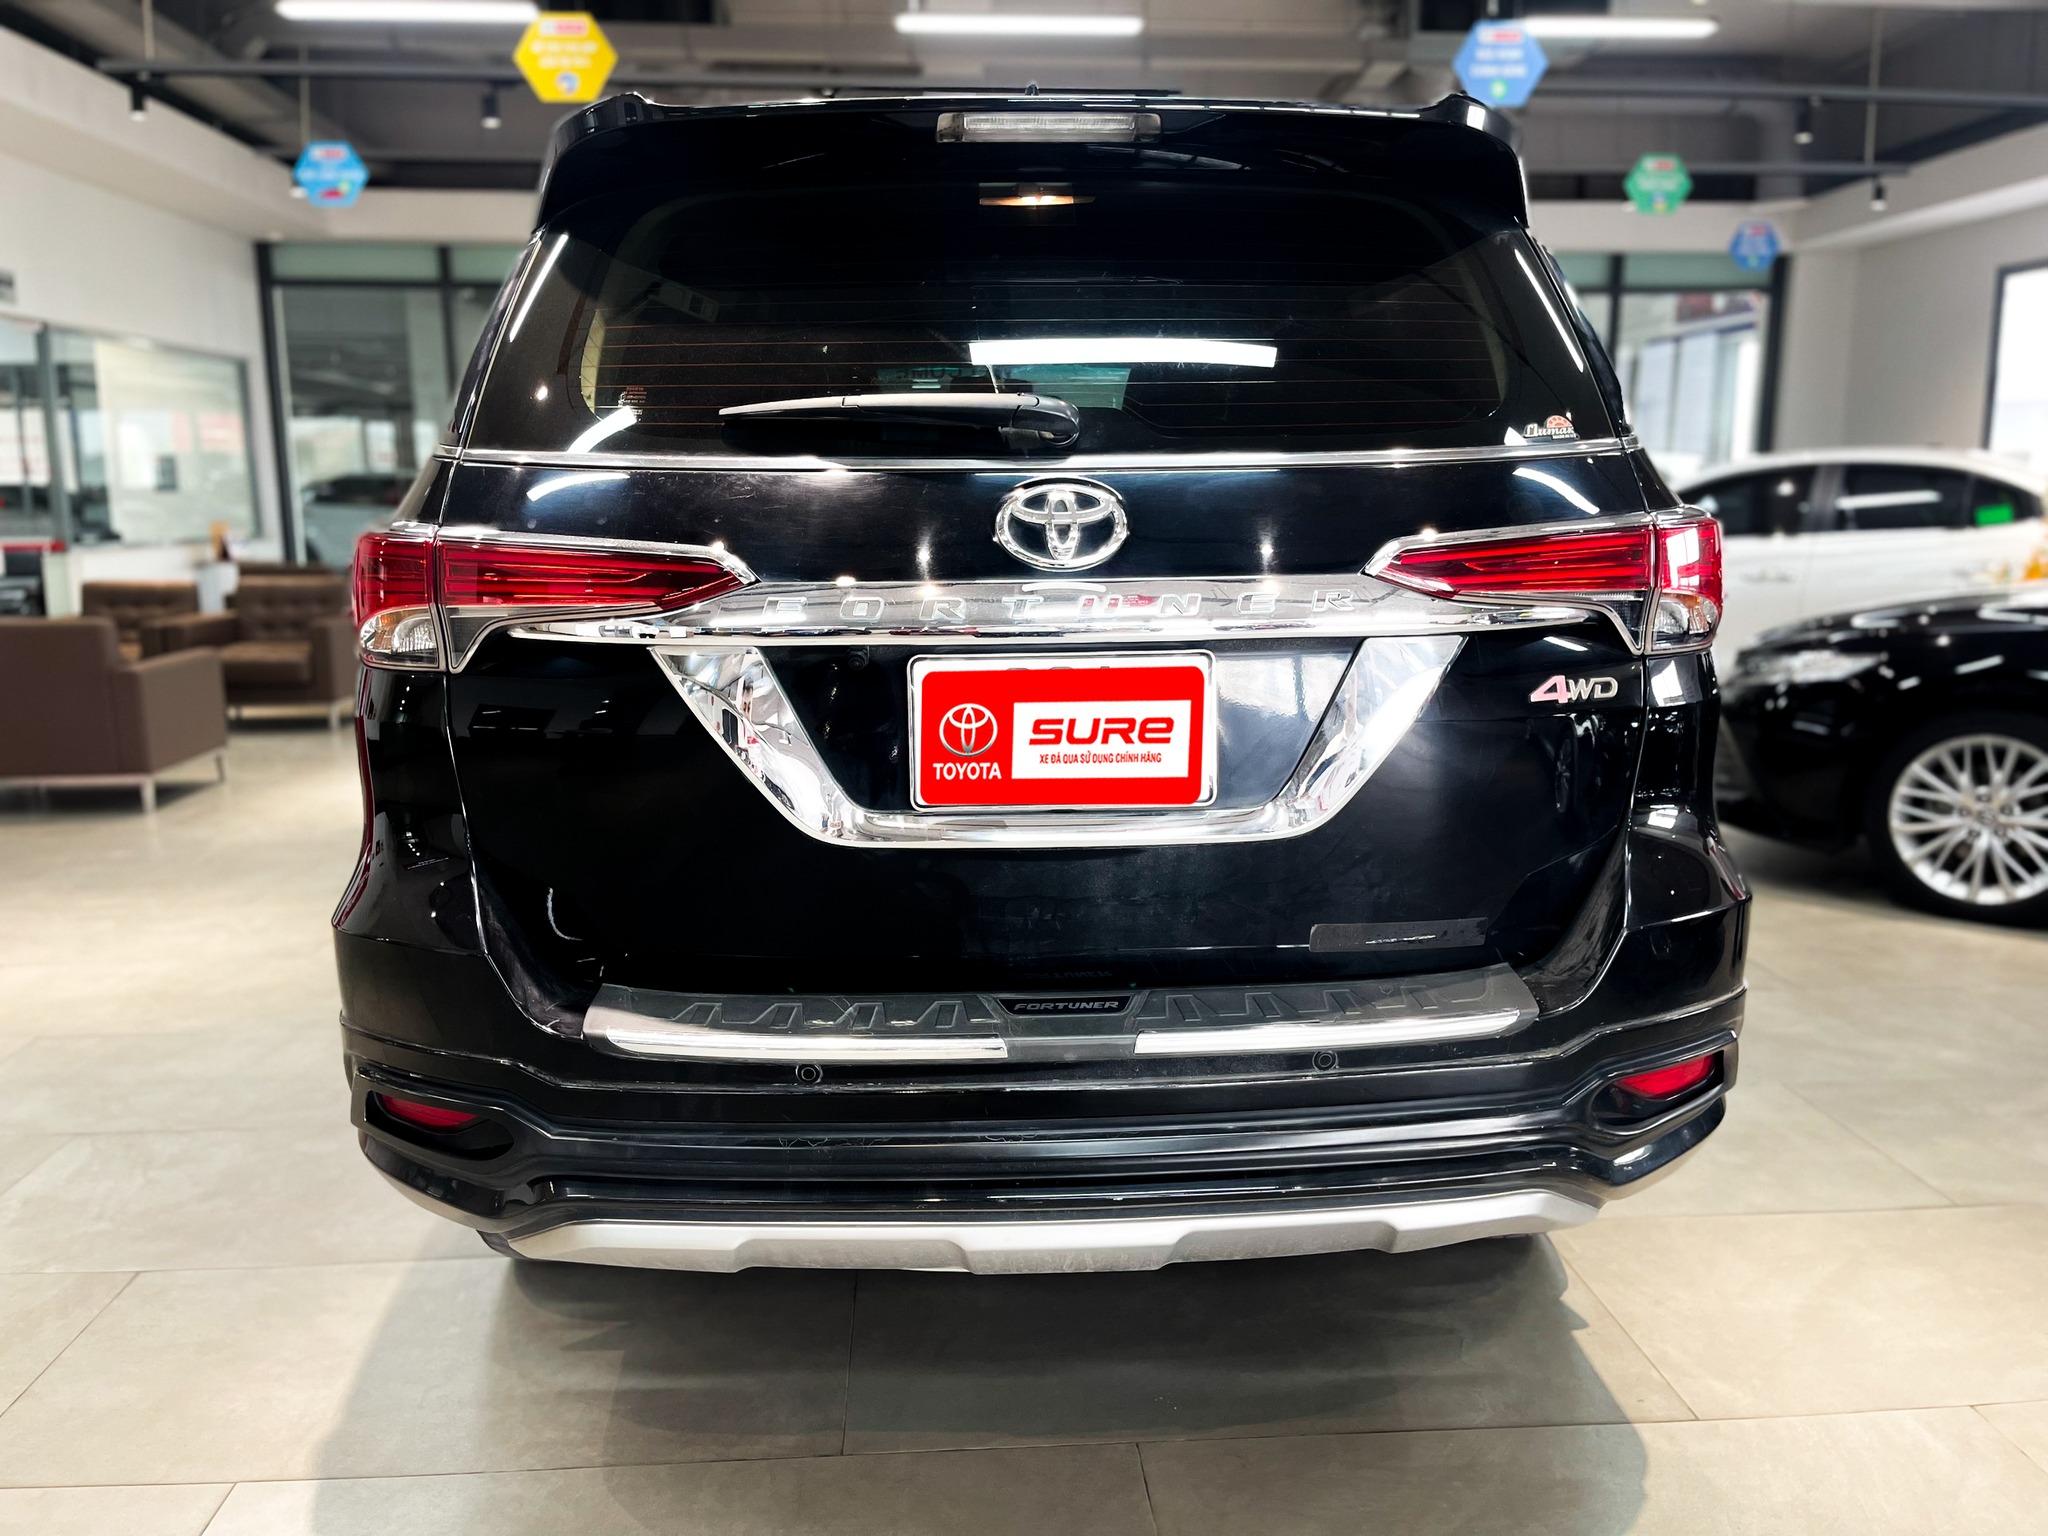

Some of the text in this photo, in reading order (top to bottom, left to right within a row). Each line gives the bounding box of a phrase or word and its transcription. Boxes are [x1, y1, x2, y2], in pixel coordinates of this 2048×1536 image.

[762, 589, 1356, 622] FORTUNER
[1530, 675, 1618, 704] 4WD
[1014, 1001, 1119, 1011] FORTUNER
